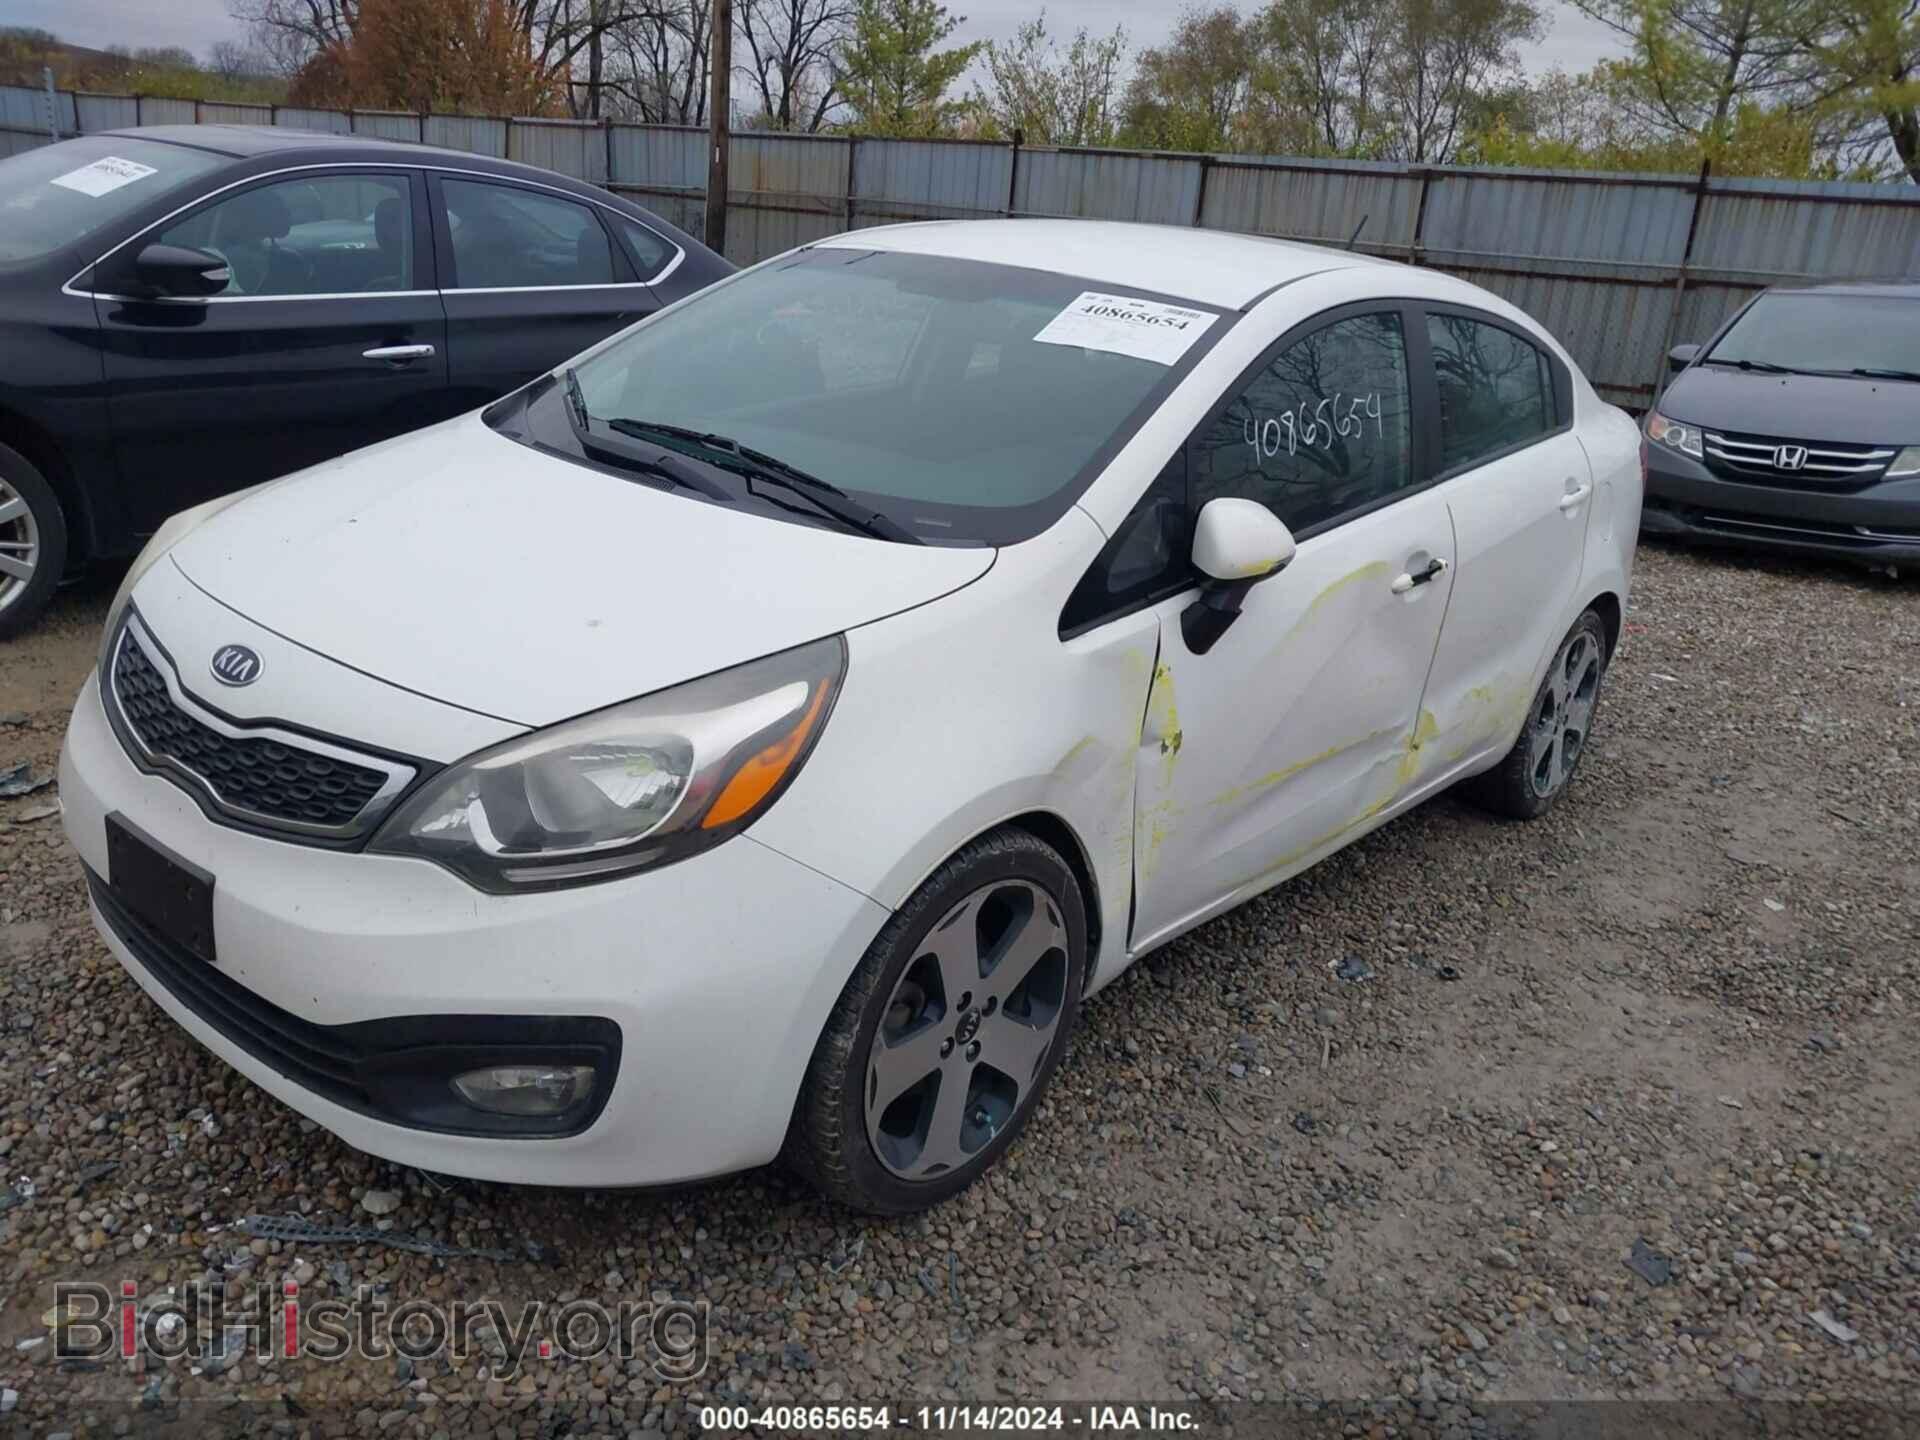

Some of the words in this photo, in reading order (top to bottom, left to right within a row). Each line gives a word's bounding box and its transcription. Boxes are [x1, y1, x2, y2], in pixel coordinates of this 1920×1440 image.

[1081, 304, 1190, 330] 40865654
[1243, 392, 1383, 466] 40865654
[215, 647, 254, 680] KIA
